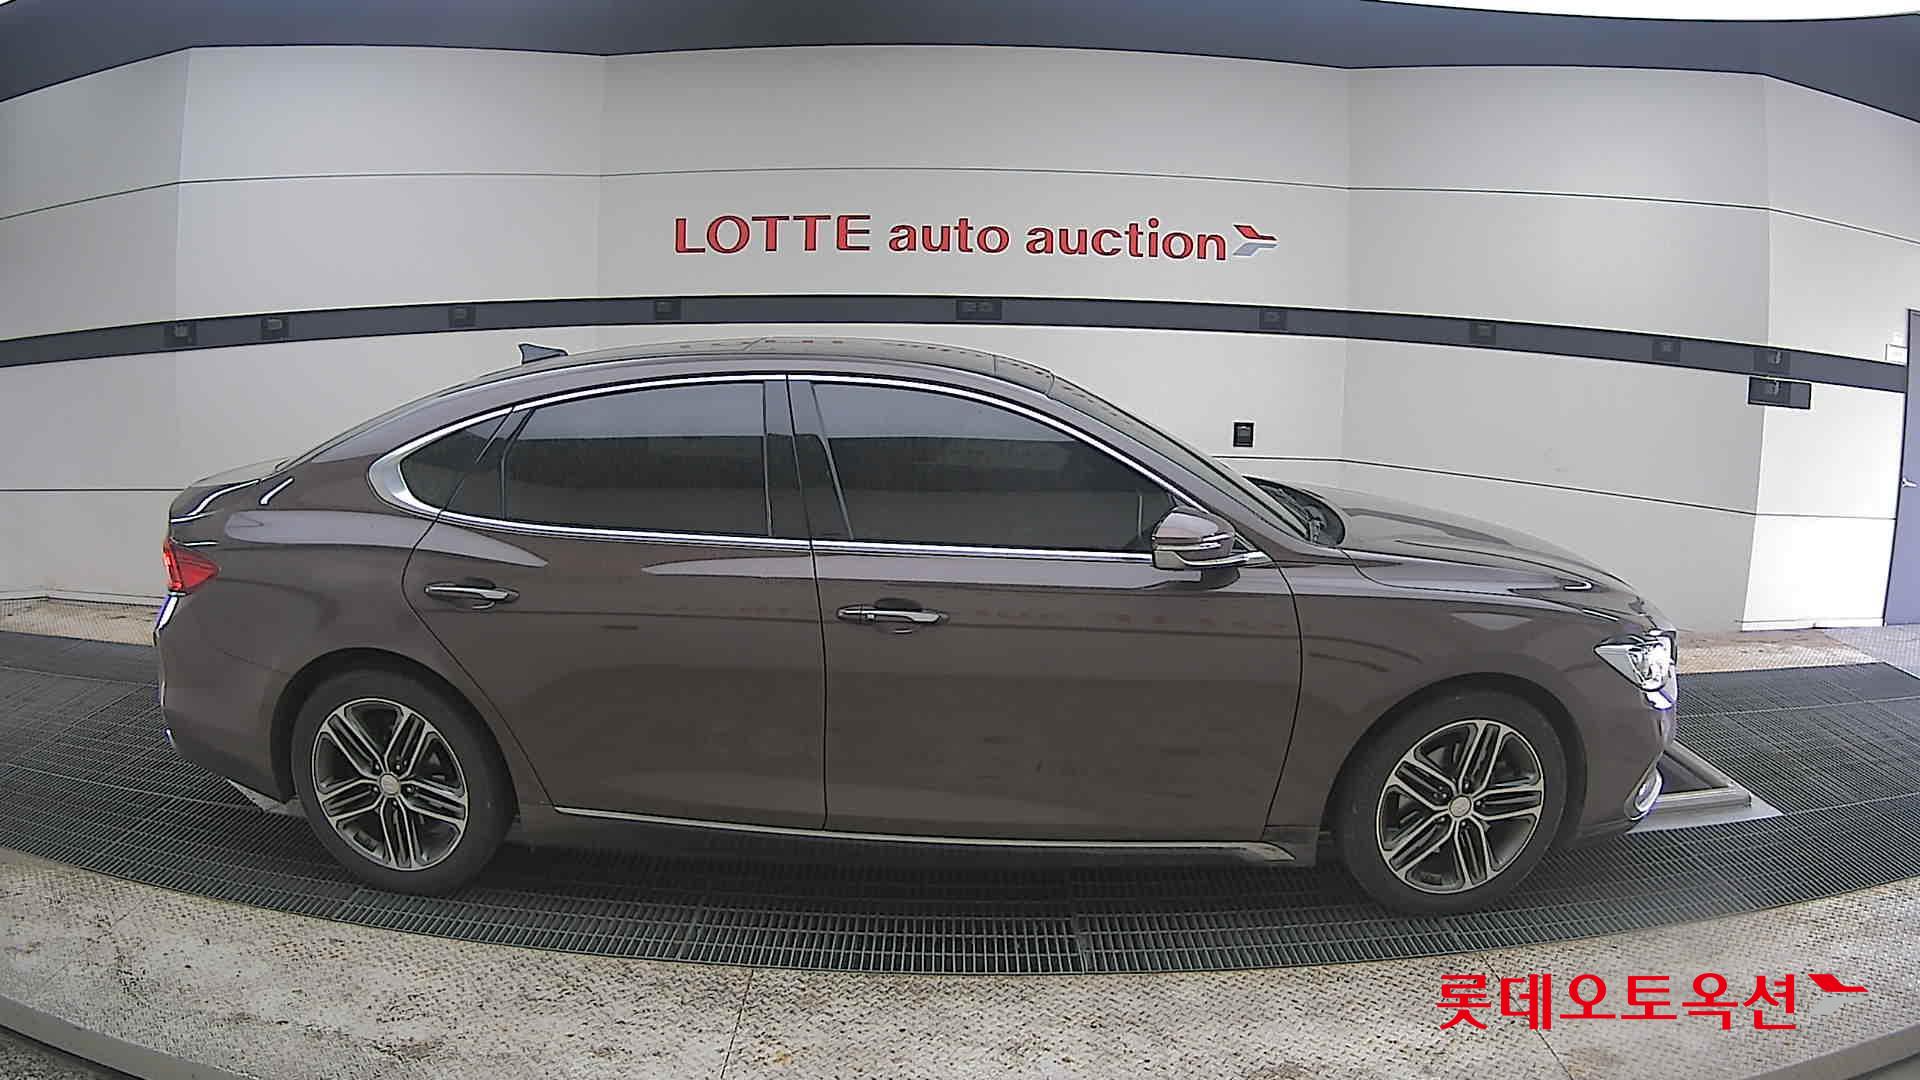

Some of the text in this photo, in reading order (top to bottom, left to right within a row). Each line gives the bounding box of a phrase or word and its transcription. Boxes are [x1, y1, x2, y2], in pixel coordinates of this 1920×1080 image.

[674, 214, 1227, 261] LOTTE auto auction
